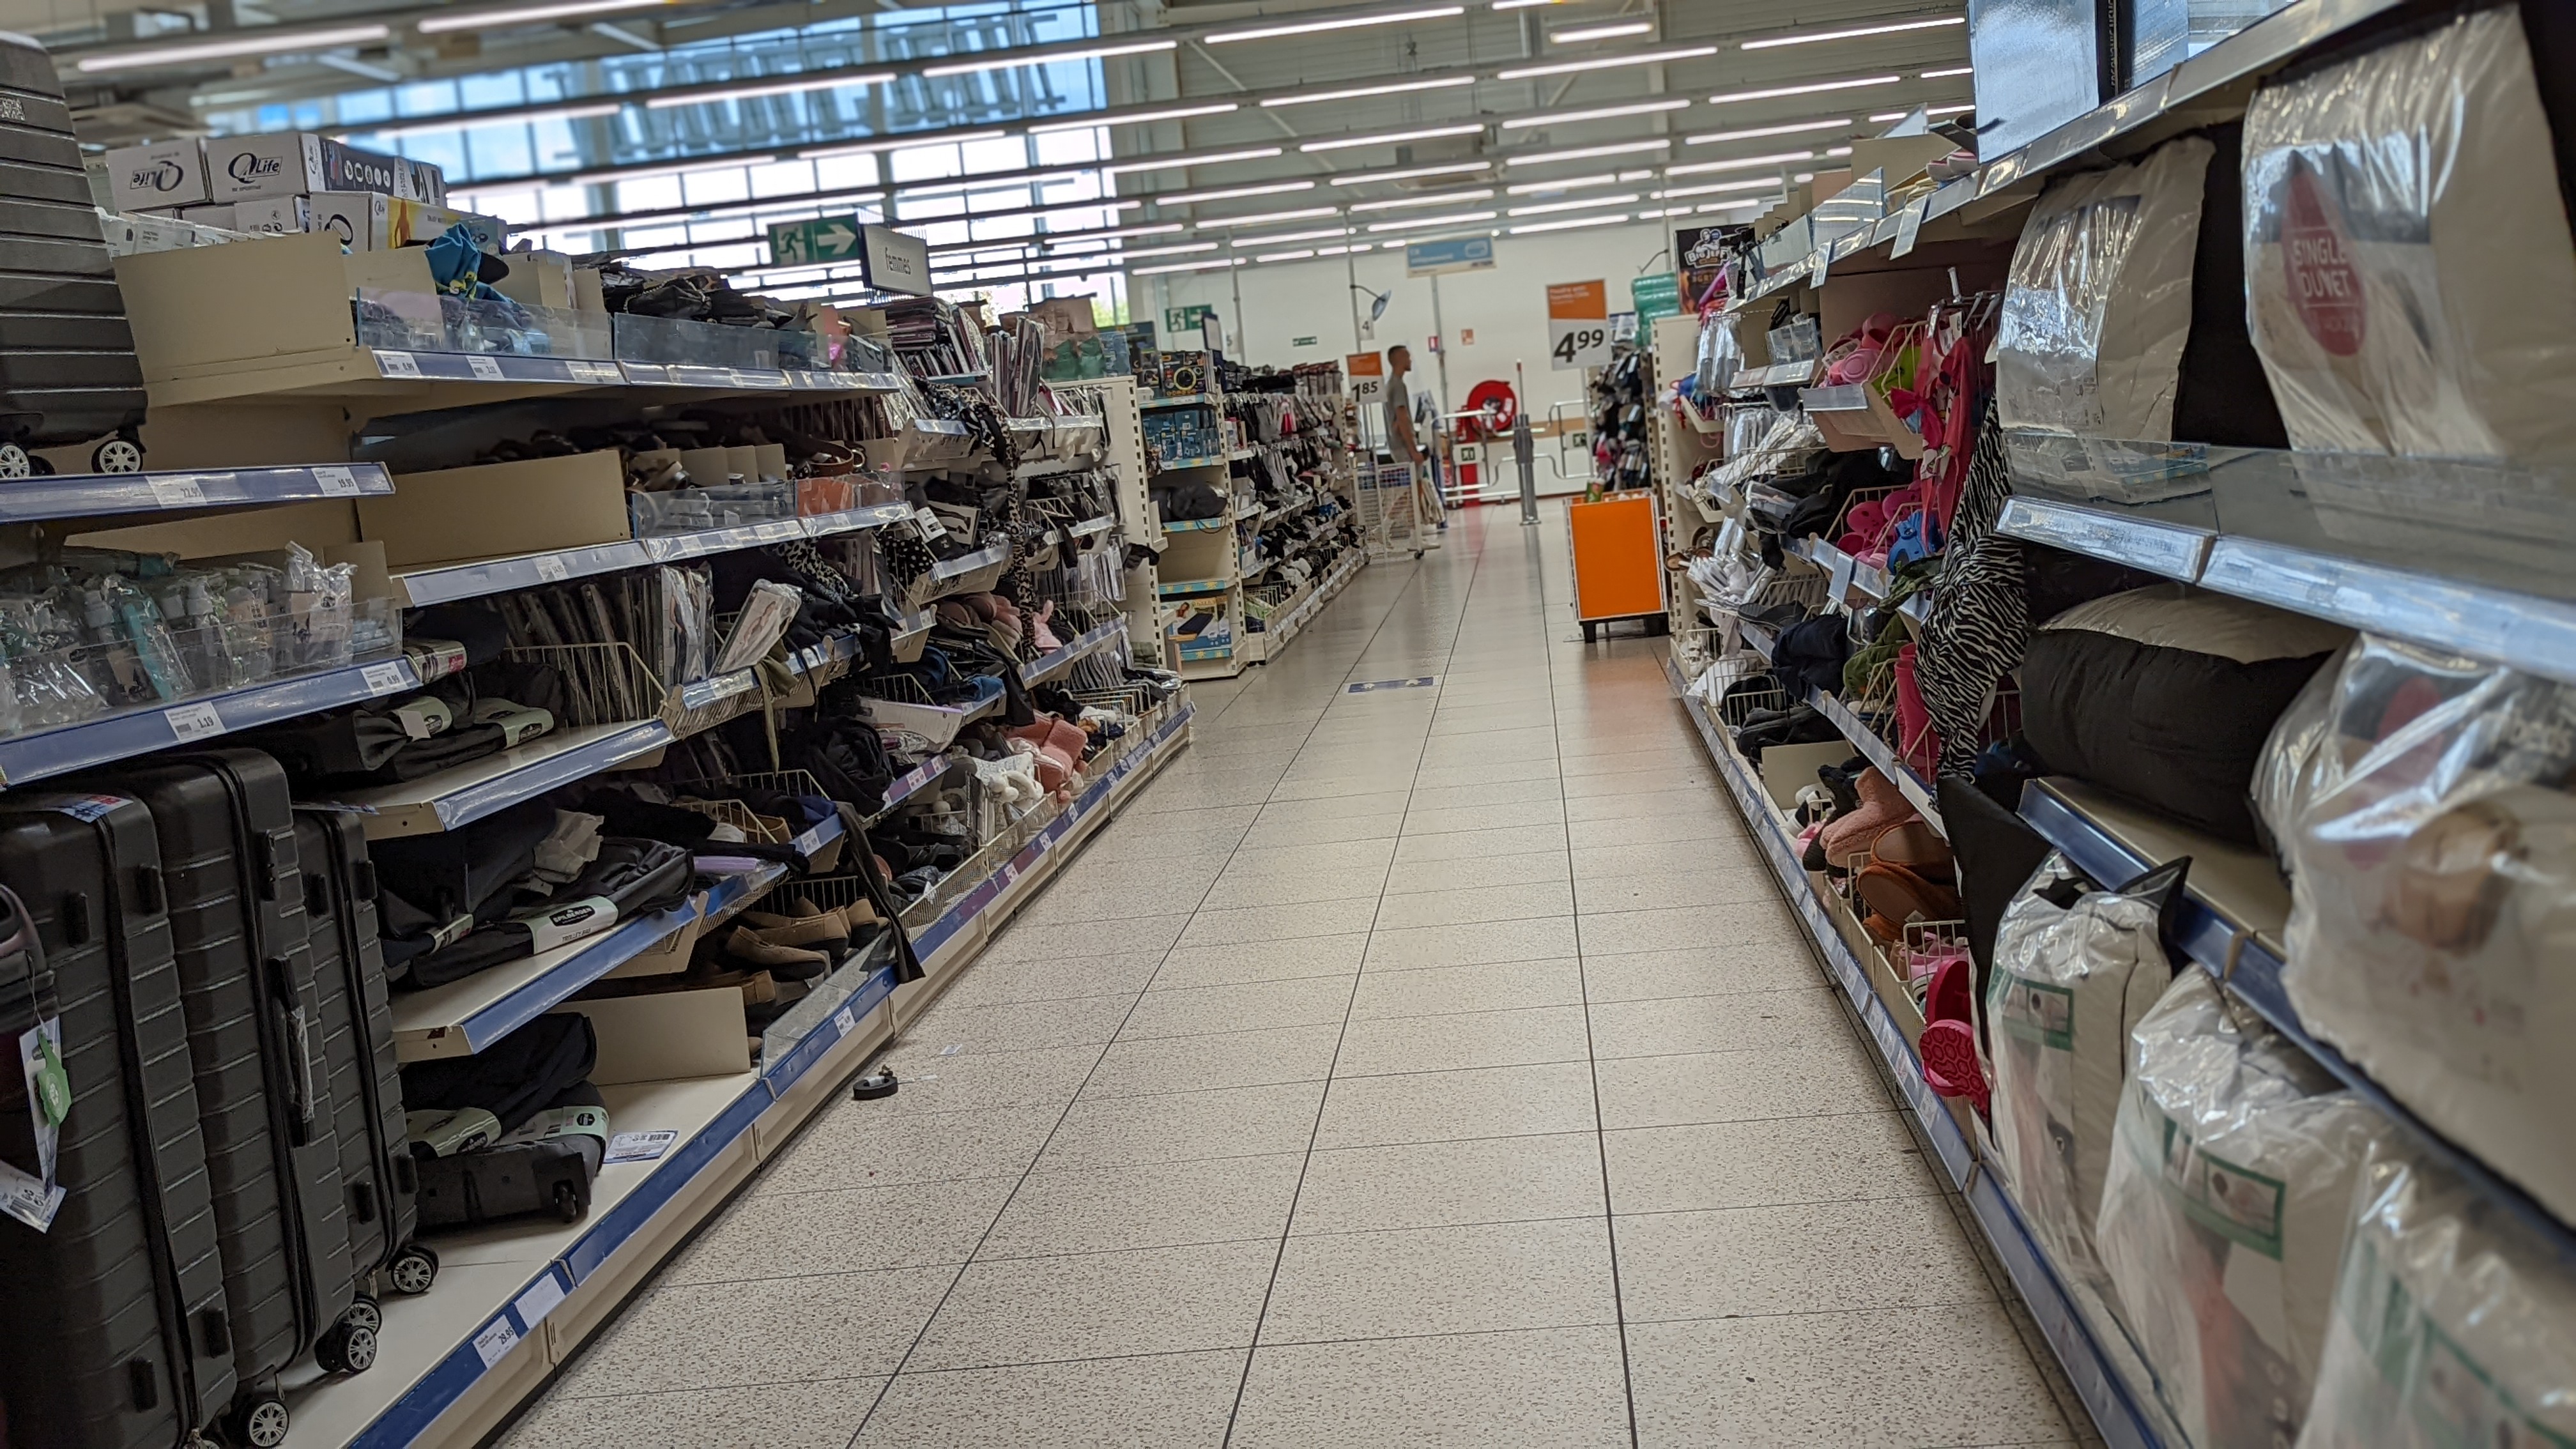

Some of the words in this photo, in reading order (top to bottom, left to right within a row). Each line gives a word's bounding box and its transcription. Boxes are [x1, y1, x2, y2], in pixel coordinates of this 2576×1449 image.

[2301, 270, 2350, 297] DUVET
[1362, 321, 1370, 330] 4
[197, 716, 214, 728] 1.19
